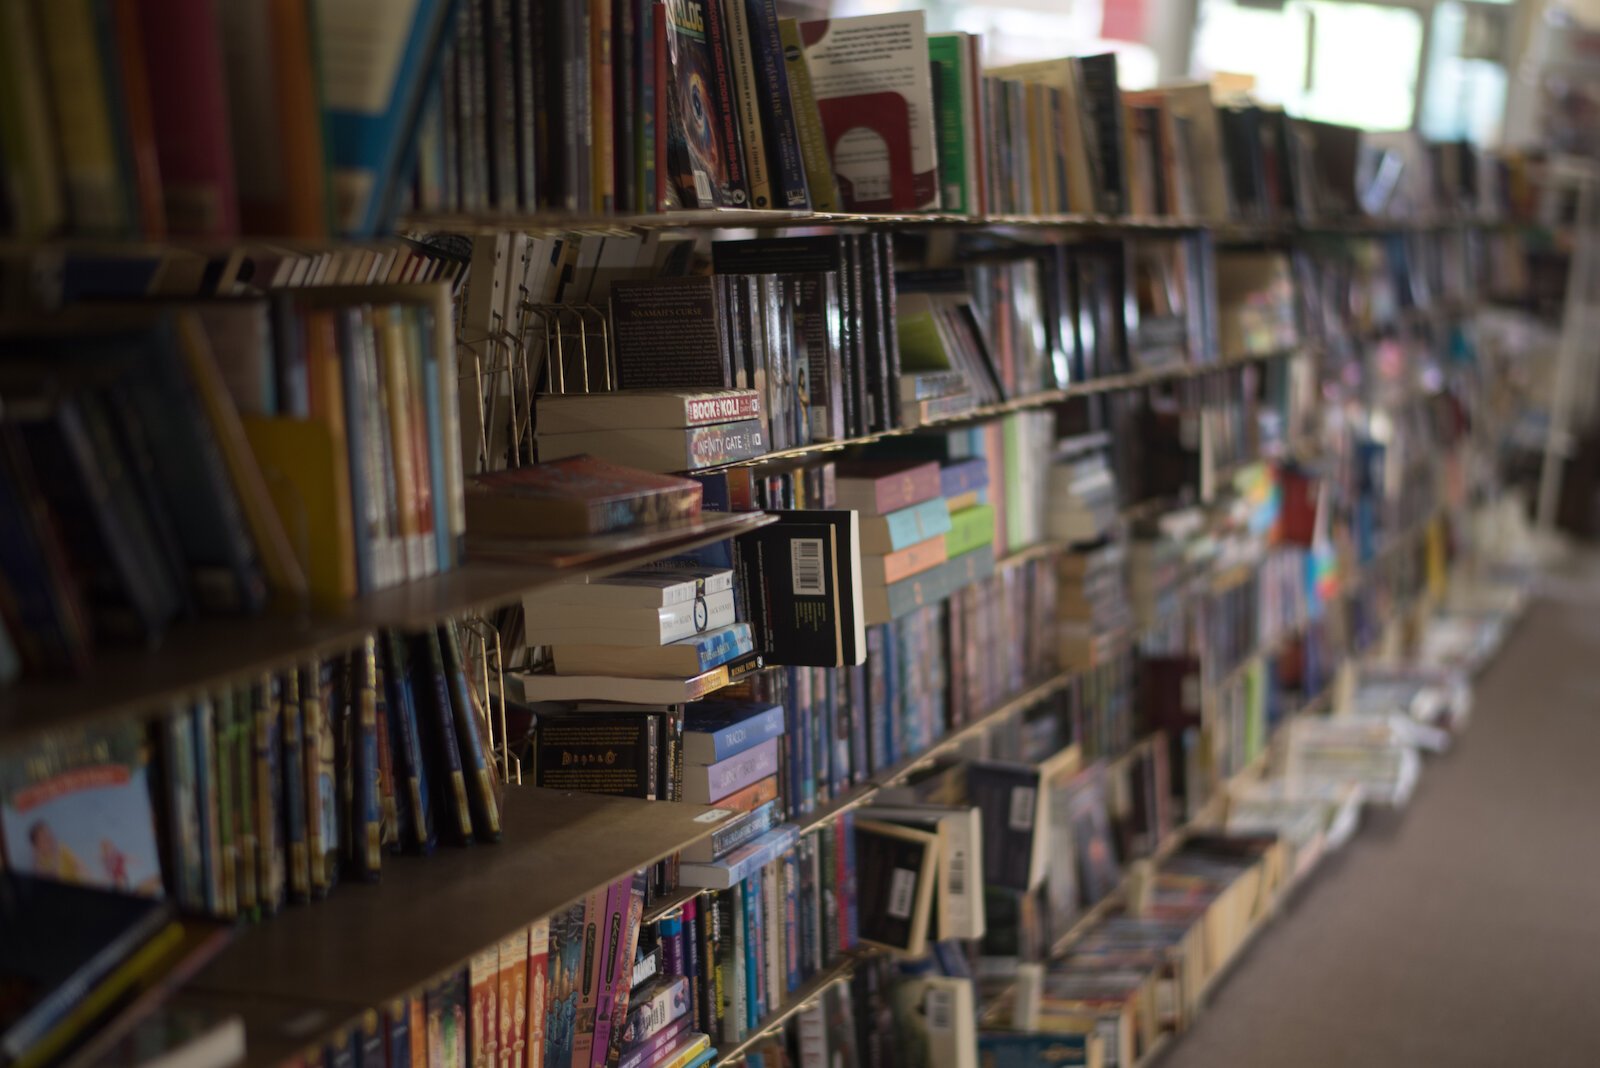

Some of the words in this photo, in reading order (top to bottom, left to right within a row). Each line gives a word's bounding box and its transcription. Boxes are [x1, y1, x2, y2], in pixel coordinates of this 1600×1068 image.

[742, 65, 750, 92] FICTION
[676, 308, 702, 318] CURSE
[693, 400, 717, 420] BOOK
[720, 399, 740, 416] KOLI
[697, 437, 724, 456] INFINITY
[725, 435, 743, 451] GATE
[562, 749, 616, 767] DIABLO
